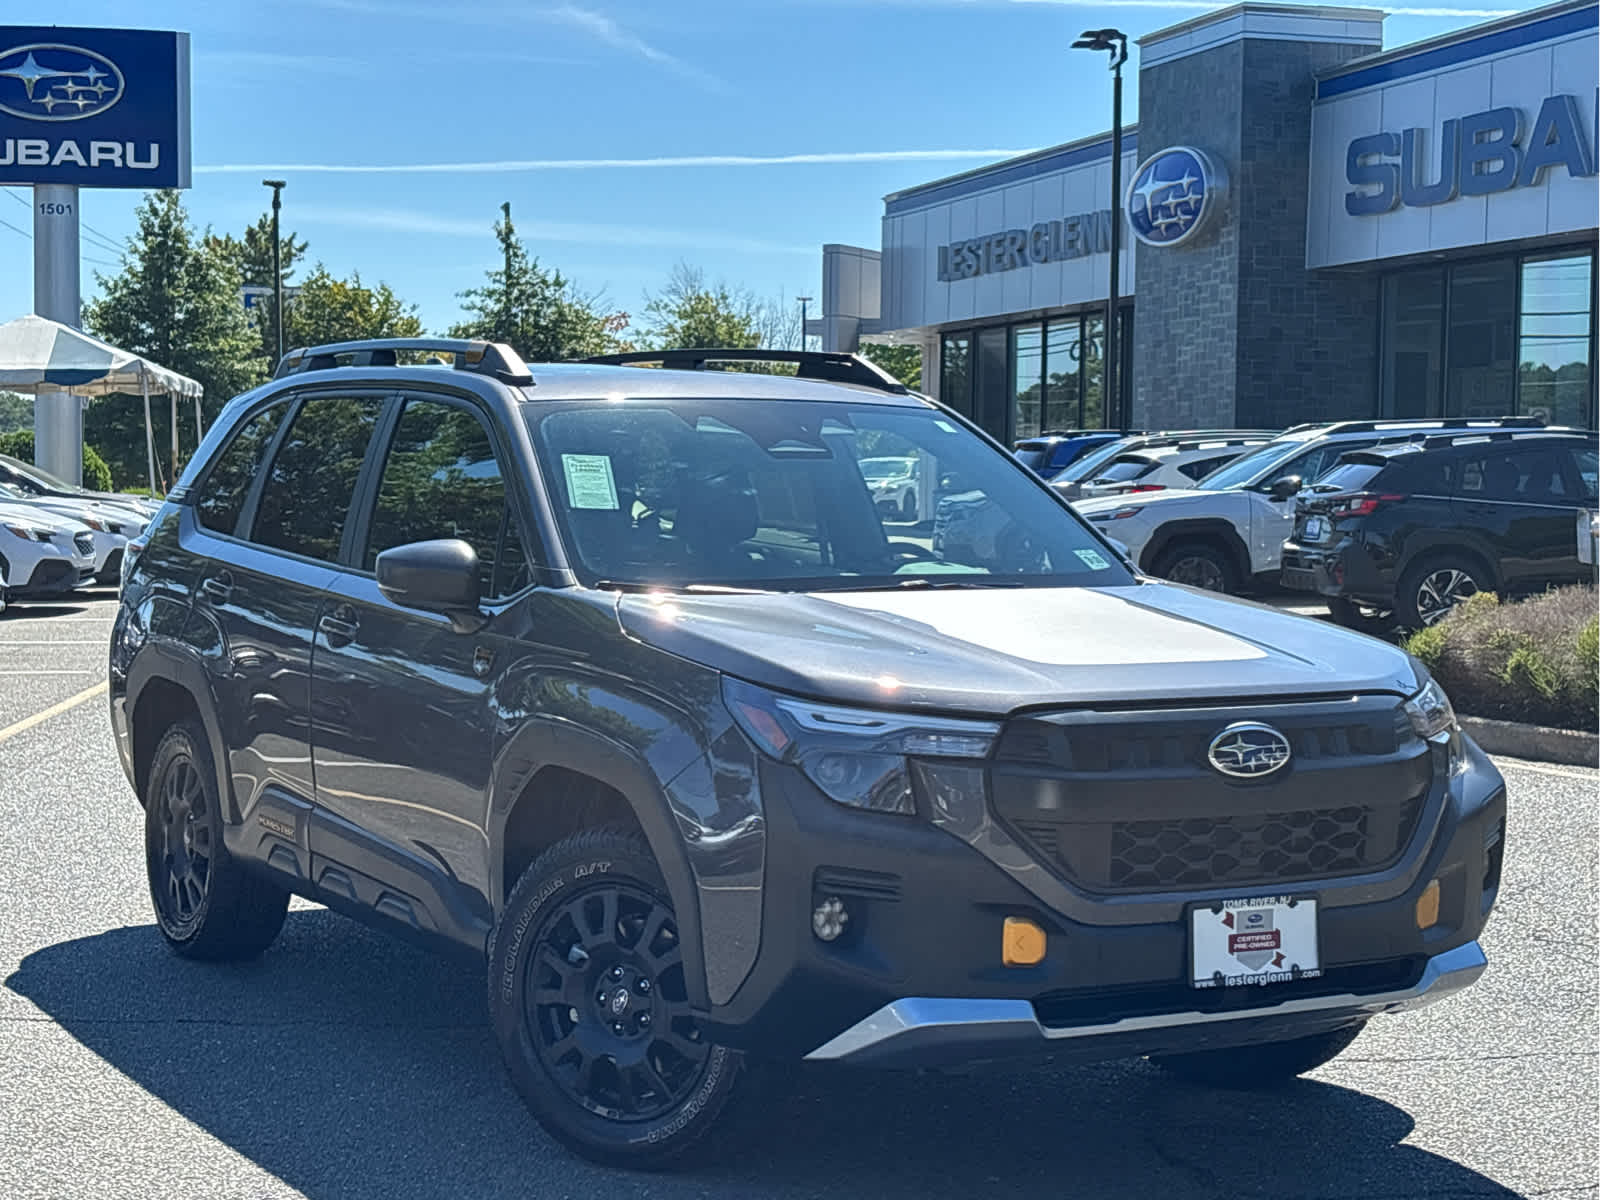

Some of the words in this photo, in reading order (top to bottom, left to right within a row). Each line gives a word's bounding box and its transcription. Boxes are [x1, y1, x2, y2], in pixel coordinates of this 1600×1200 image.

[1345, 86, 1598, 216] SUBA
[40, 203, 73, 216] 1501
[937, 229, 1032, 282] LESTER
[1030, 209, 1128, 264] GLENN
[575, 861, 612, 879] A/T
[1222, 899, 1247, 909] TOMS
[1280, 895, 1292, 904] NJ
[1233, 941, 1277, 950] PRE-OWNED
[1236, 934, 1273, 943] CERTIFIED
